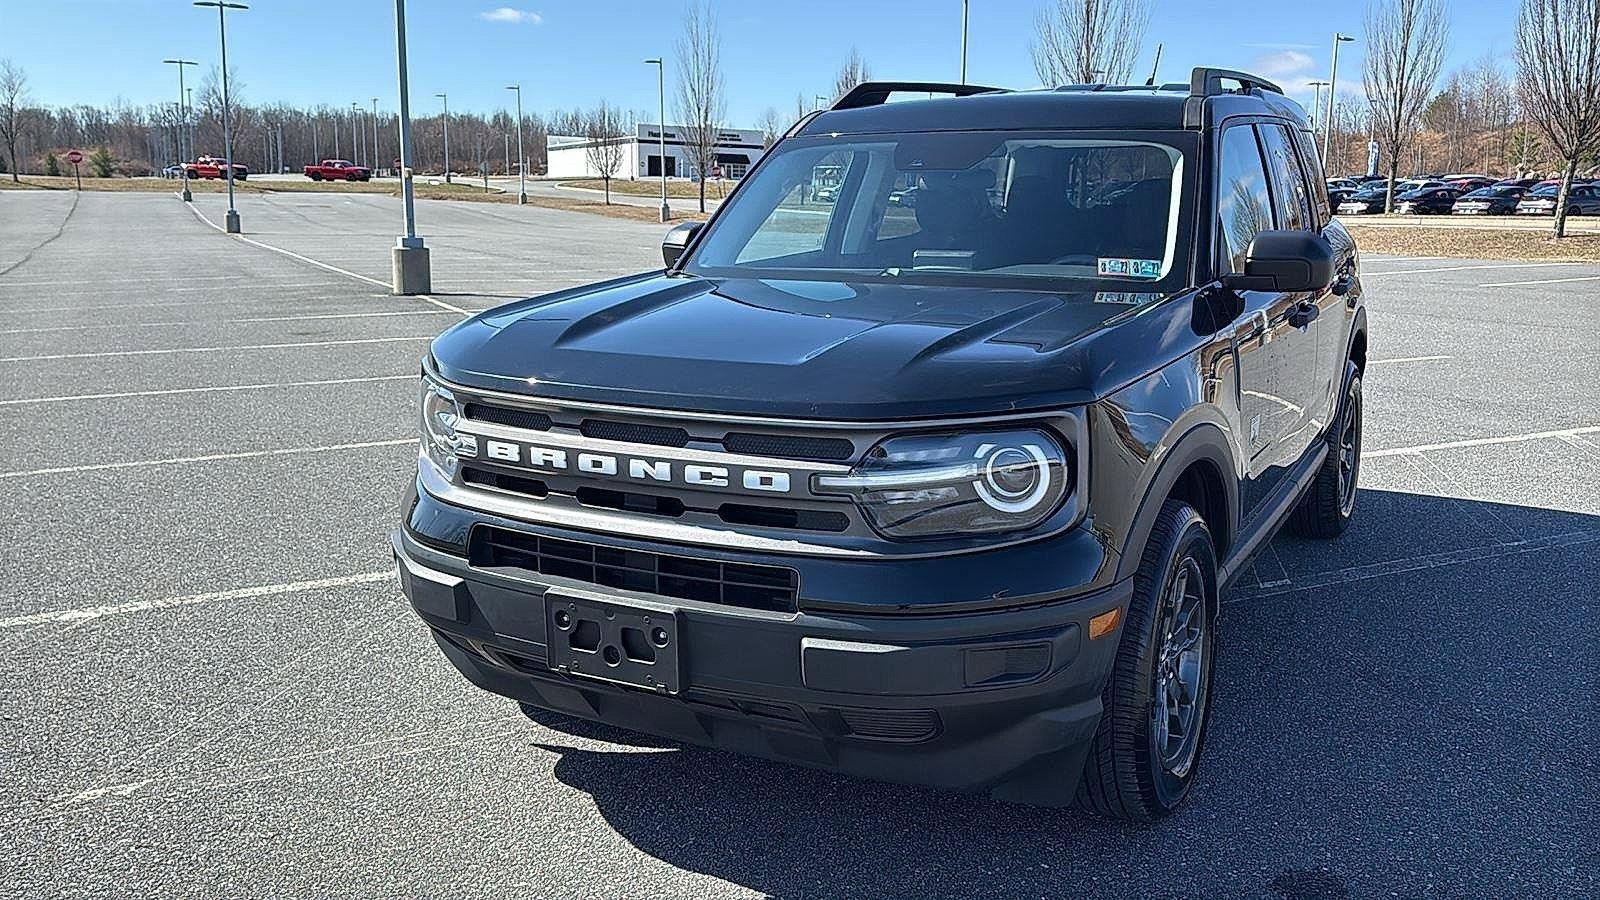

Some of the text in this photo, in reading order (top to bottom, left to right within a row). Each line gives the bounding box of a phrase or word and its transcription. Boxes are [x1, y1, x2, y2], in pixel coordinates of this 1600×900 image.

[1101, 262, 1106, 273] 3
[1133, 261, 1140, 273] 3
[487, 439, 790, 493] BRONCO
